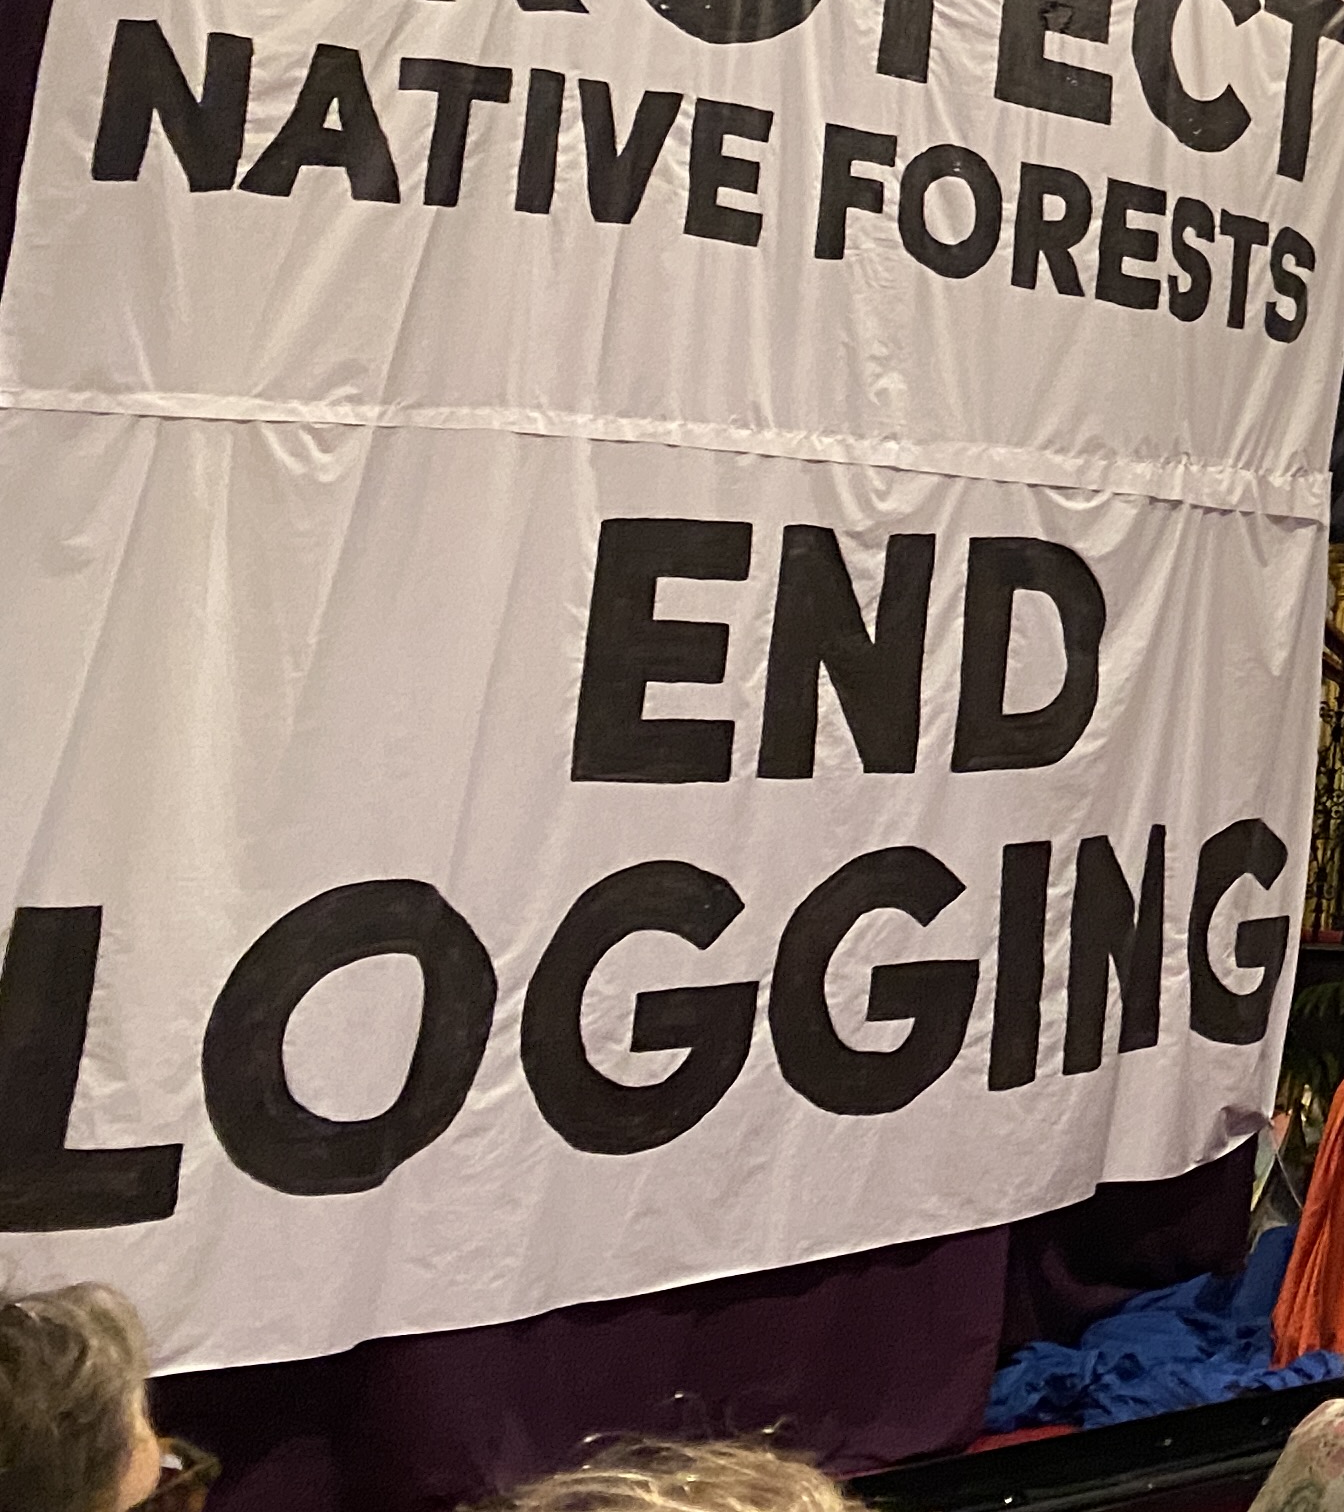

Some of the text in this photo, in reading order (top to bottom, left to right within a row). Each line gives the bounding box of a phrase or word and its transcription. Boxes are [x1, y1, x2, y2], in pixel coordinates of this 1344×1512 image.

[91, 19, 1317, 343] NATIVE FORESTS
[571, 517, 1106, 783] END
[0, 817, 1290, 1233] LOGGING
